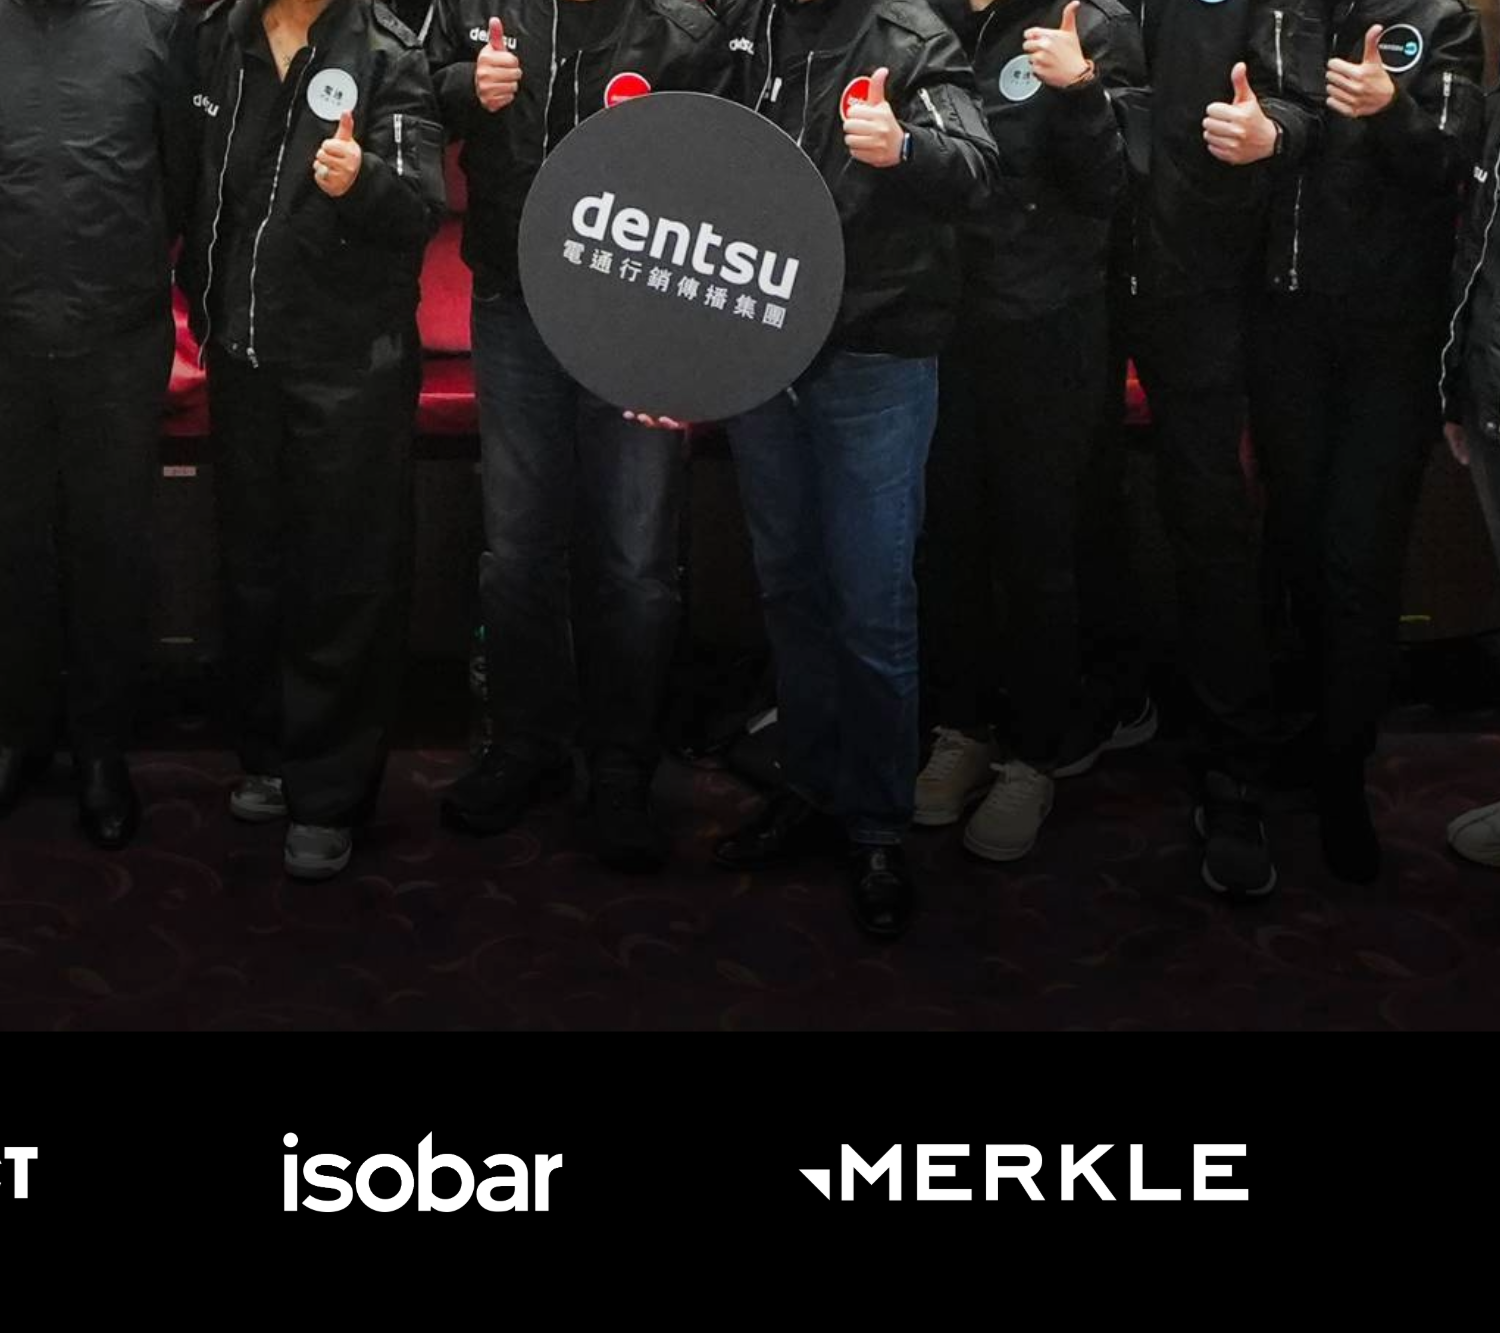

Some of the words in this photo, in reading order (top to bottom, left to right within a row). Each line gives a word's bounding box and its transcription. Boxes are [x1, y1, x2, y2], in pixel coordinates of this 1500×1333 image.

[561, 239, 787, 330] 電通行銷傳播集團
[571, 190, 801, 299] dentsu
